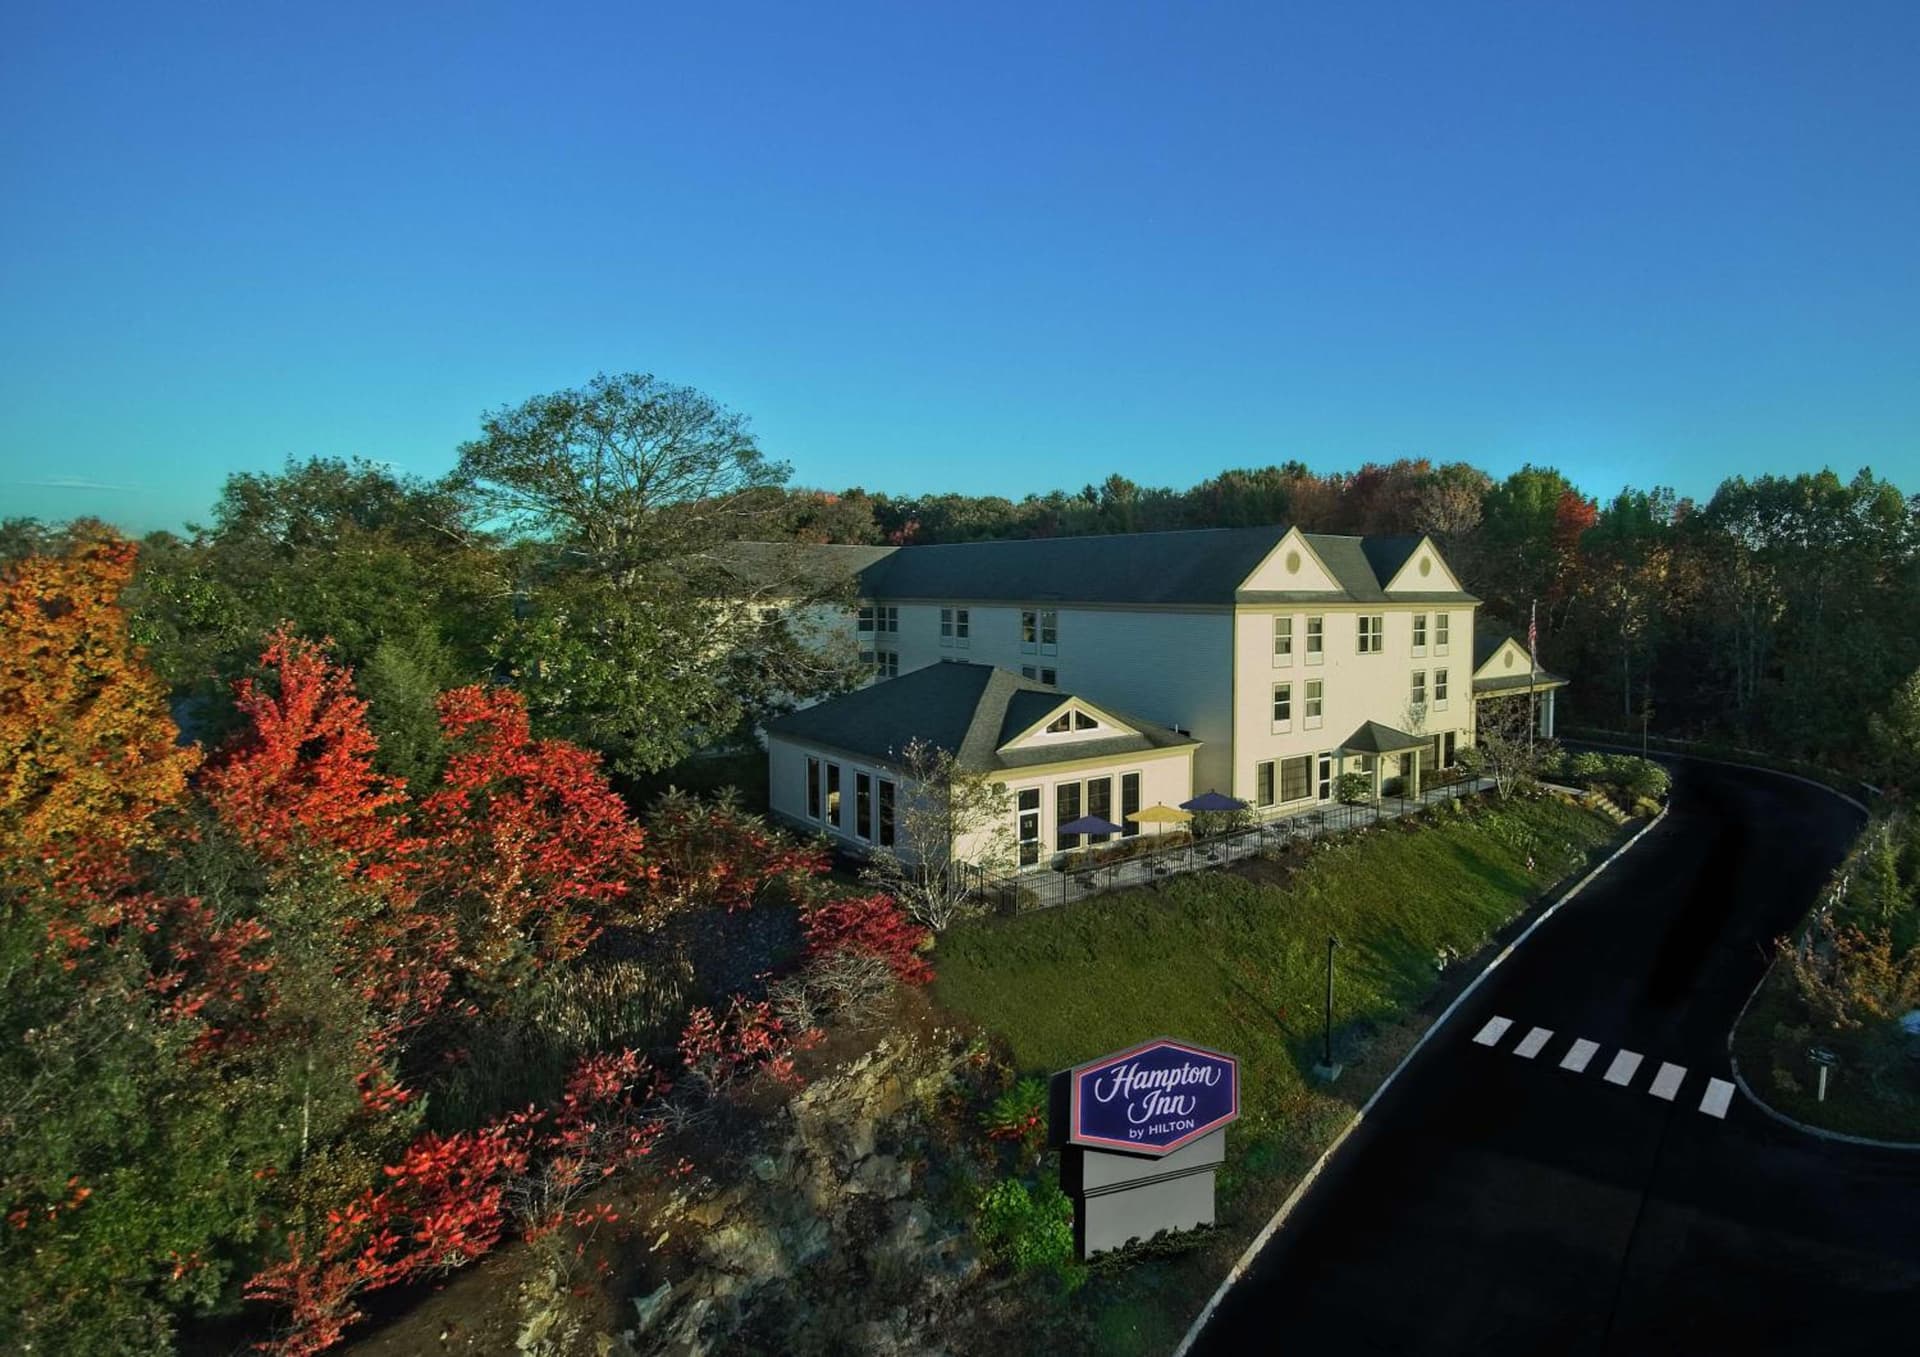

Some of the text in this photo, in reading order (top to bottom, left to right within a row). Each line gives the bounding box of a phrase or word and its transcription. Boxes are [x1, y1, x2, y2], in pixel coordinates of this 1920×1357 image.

[1095, 1062, 1221, 1102] Hampton
[1128, 1089, 1196, 1124] Inn
[1129, 1119, 1195, 1139] by HILTON
